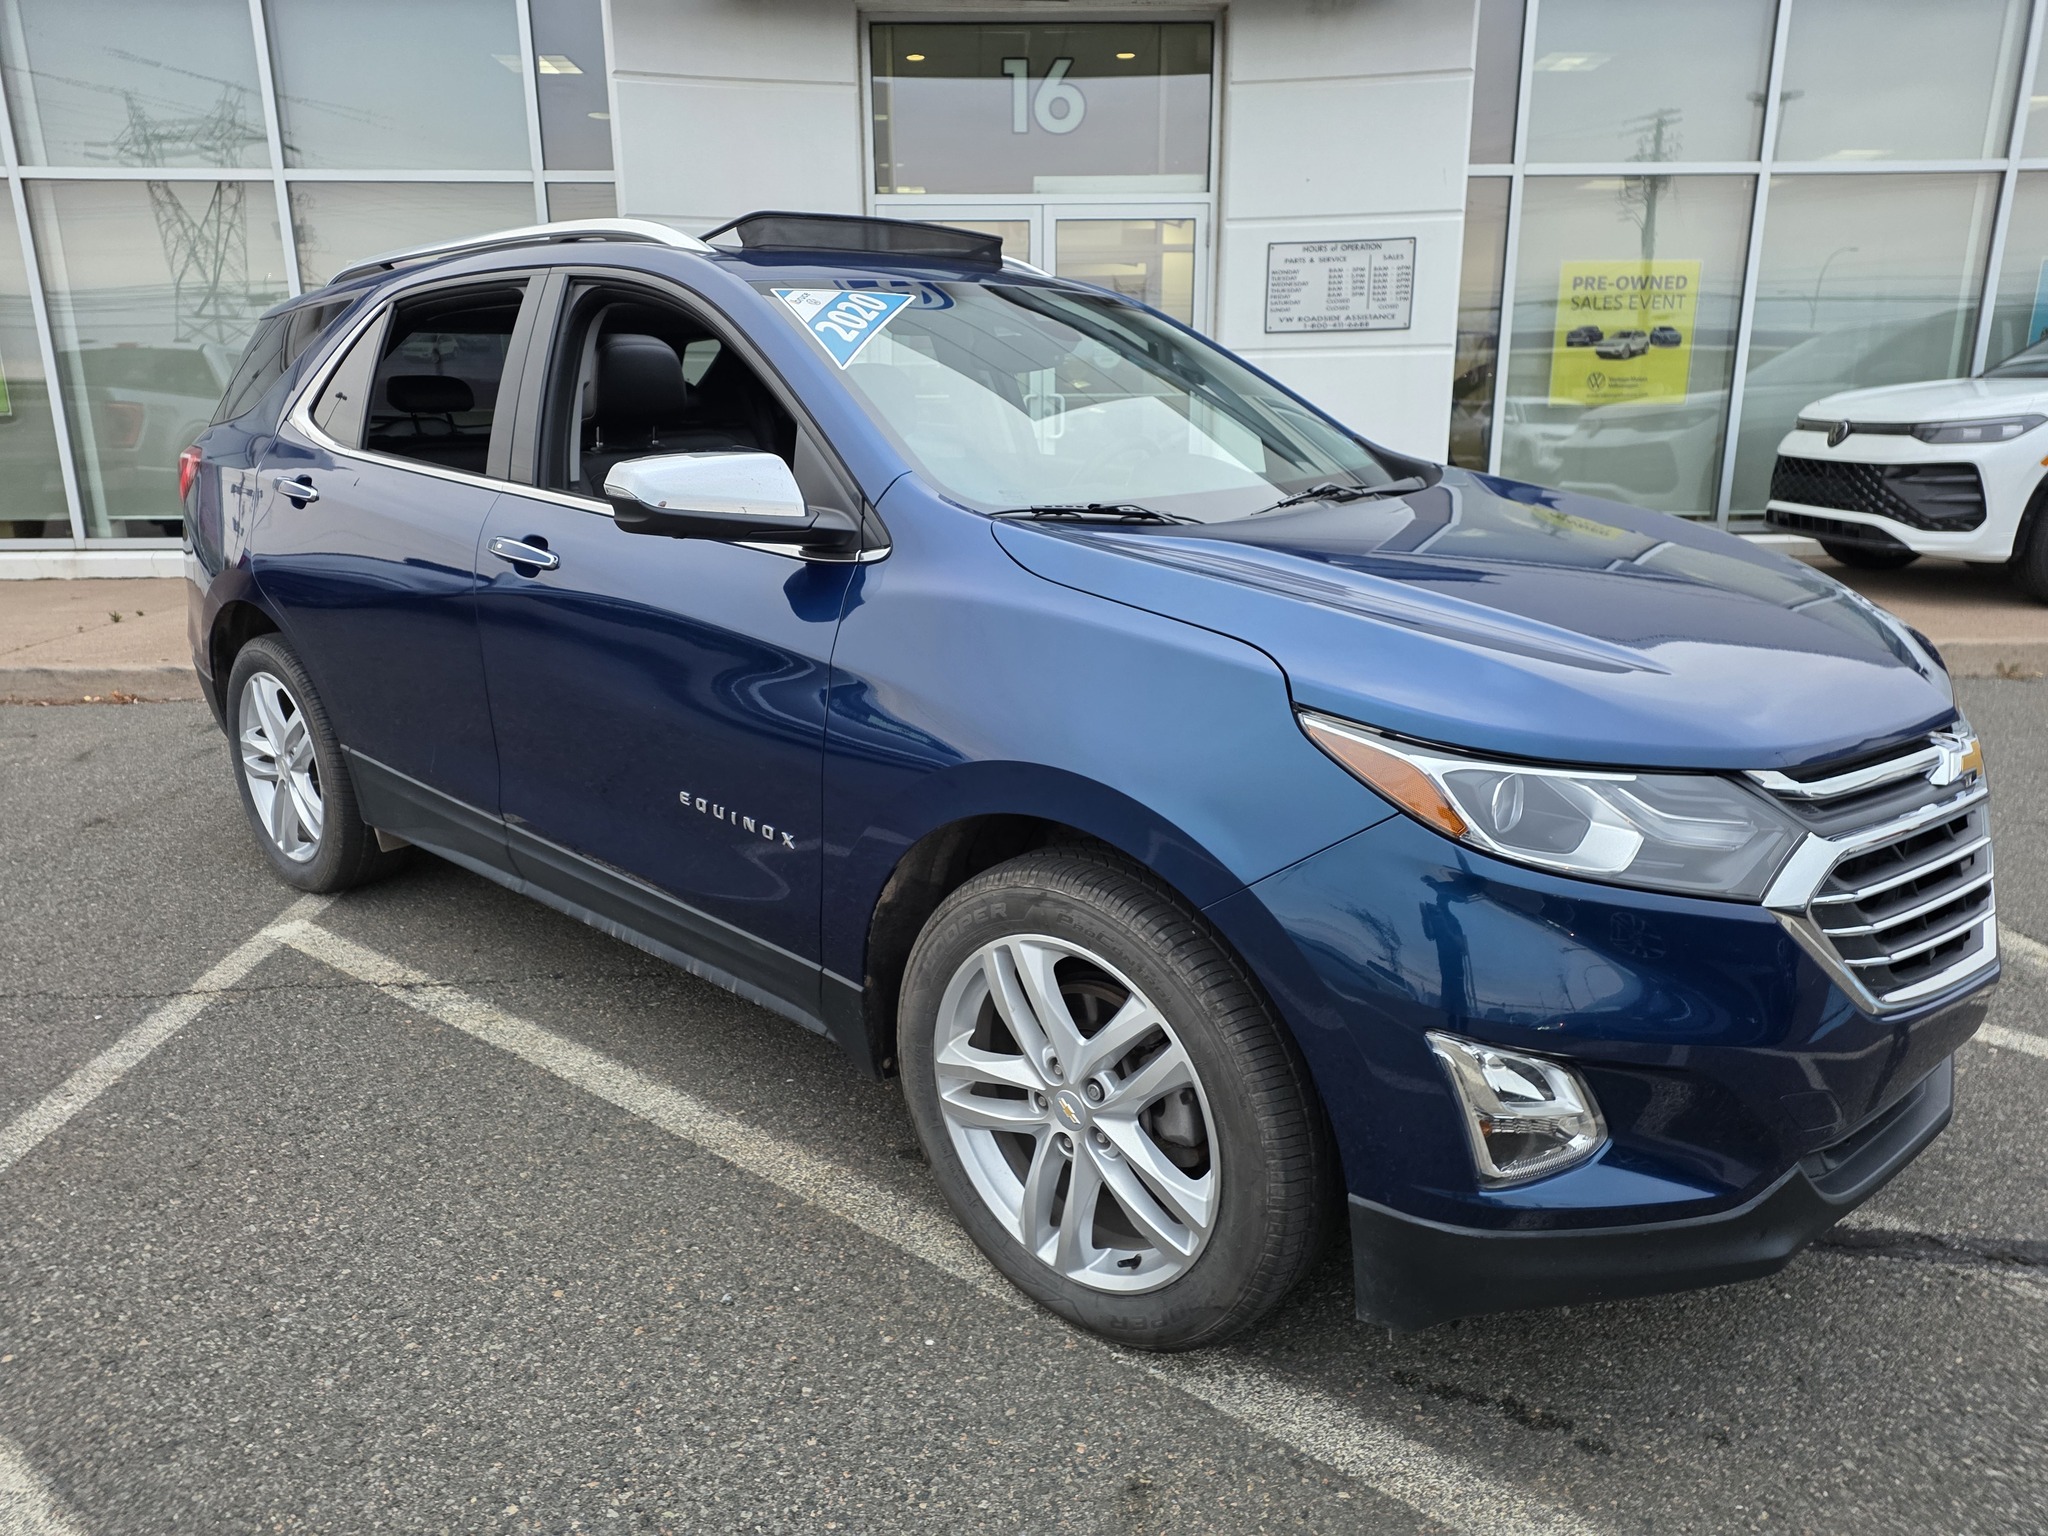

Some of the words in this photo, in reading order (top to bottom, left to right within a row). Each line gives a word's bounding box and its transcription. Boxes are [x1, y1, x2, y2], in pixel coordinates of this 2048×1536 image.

[1002, 57, 1087, 135] 16
[1302, 245, 1327, 253] HOURS
[1340, 243, 1383, 251] OPERATION
[1572, 275, 1688, 291] PRE-OWNED
[1571, 295, 1624, 311] SALES
[1628, 294, 1687, 310] EVENT
[815, 293, 888, 342] 2020
[1344, 313, 1396, 321] ASSISTANCE
[679, 790, 795, 850] EQUINOX
